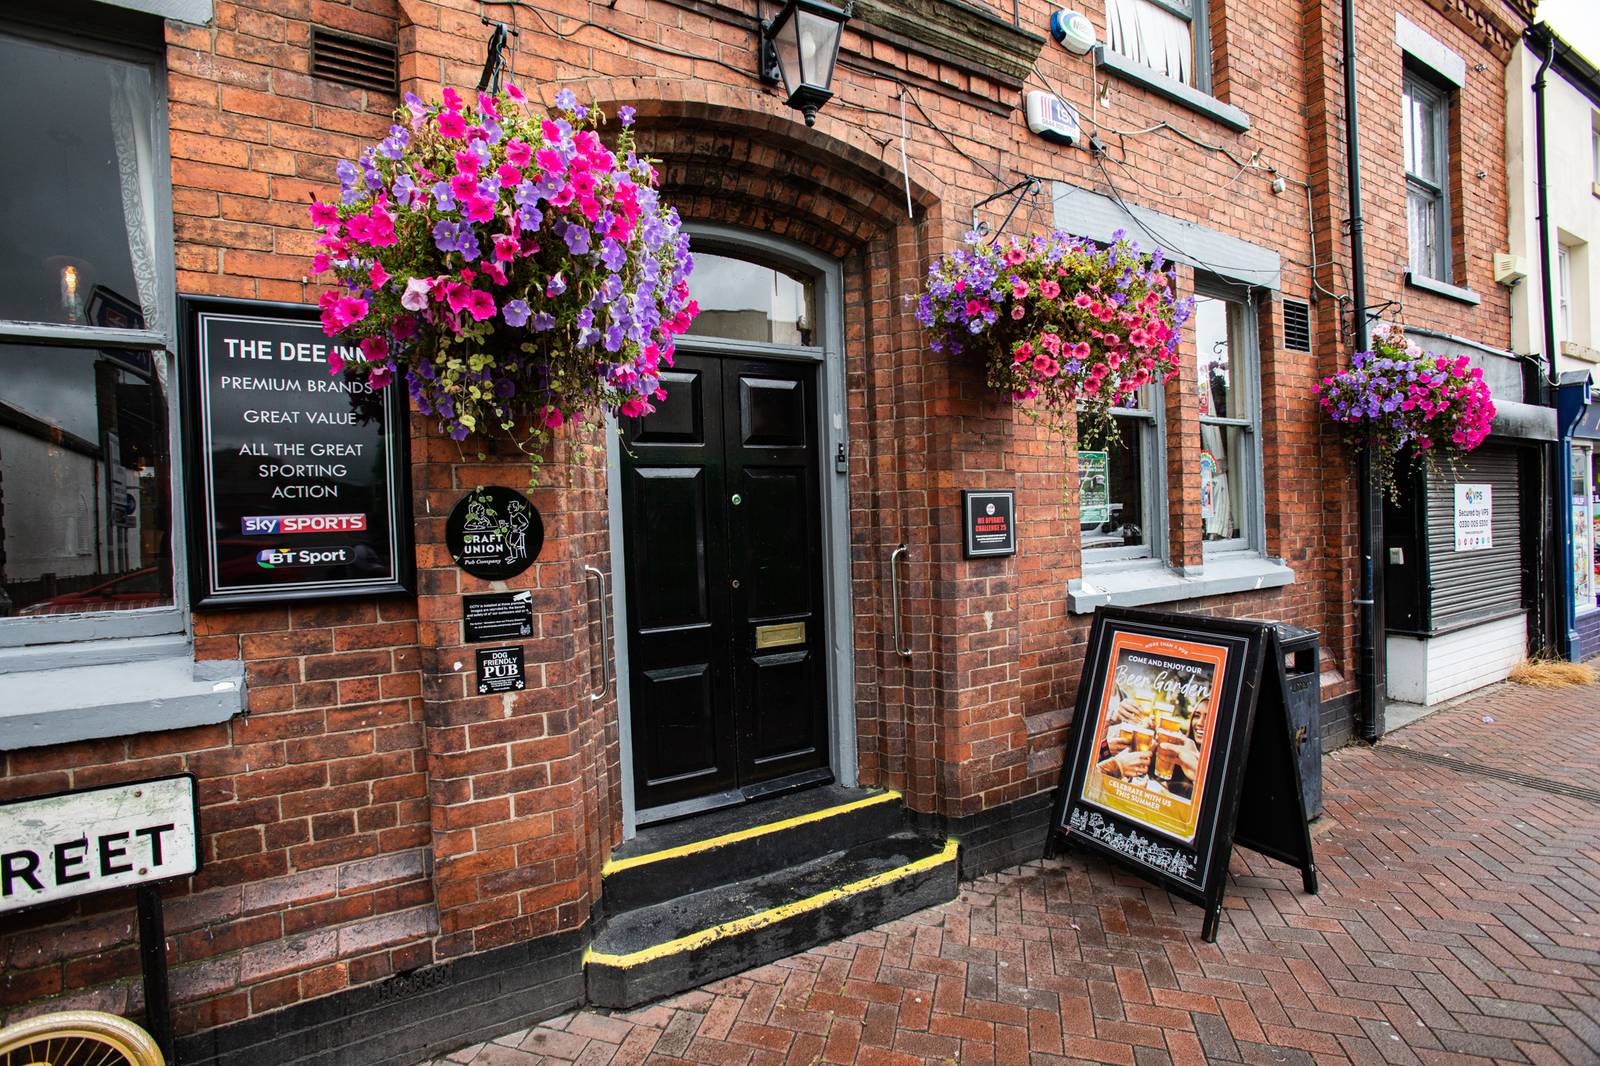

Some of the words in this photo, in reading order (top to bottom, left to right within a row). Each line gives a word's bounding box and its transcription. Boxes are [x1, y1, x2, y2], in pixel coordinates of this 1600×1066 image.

[224, 338, 273, 360] THE
[280, 341, 327, 363] DEE
[221, 376, 302, 392] PREMIUM
[308, 380, 373, 394] BRANDS
[243, 410, 300, 424] GREAT
[305, 411, 357, 425] VALUE
[238, 443, 269, 456] ALL
[274, 443, 305, 456] THE
[310, 444, 364, 456] GREAT
[258, 464, 347, 478] SPORTING
[271, 485, 338, 499] ACTION
[1473, 491, 1483, 500] VPS
[245, 518, 278, 534] sky
[283, 516, 363, 531] SPORTS
[464, 544, 503, 554] UNION
[268, 551, 297, 565] BT
[299, 549, 346, 564] Sport
[483, 657, 518, 666] FRIENDLY
[492, 652, 508, 660] DOG
[483, 663, 518, 678] PUB
[1128, 655, 1147, 664] COME
[1148, 659, 1162, 667] AND
[1163, 662, 1186, 671] ENJOY
[1186, 665, 1202, 674] OUR
[1115, 664, 1151, 687] Beer
[1153, 670, 1210, 698] Garden
[1108, 779, 1144, 796] CELEBRATE
[1144, 790, 1162, 803] WITH
[1162, 798, 1172, 807] US
[1115, 788, 1132, 799] THIS
[1131, 793, 1160, 810] SUMMER
[0, 823, 174, 896] REET
